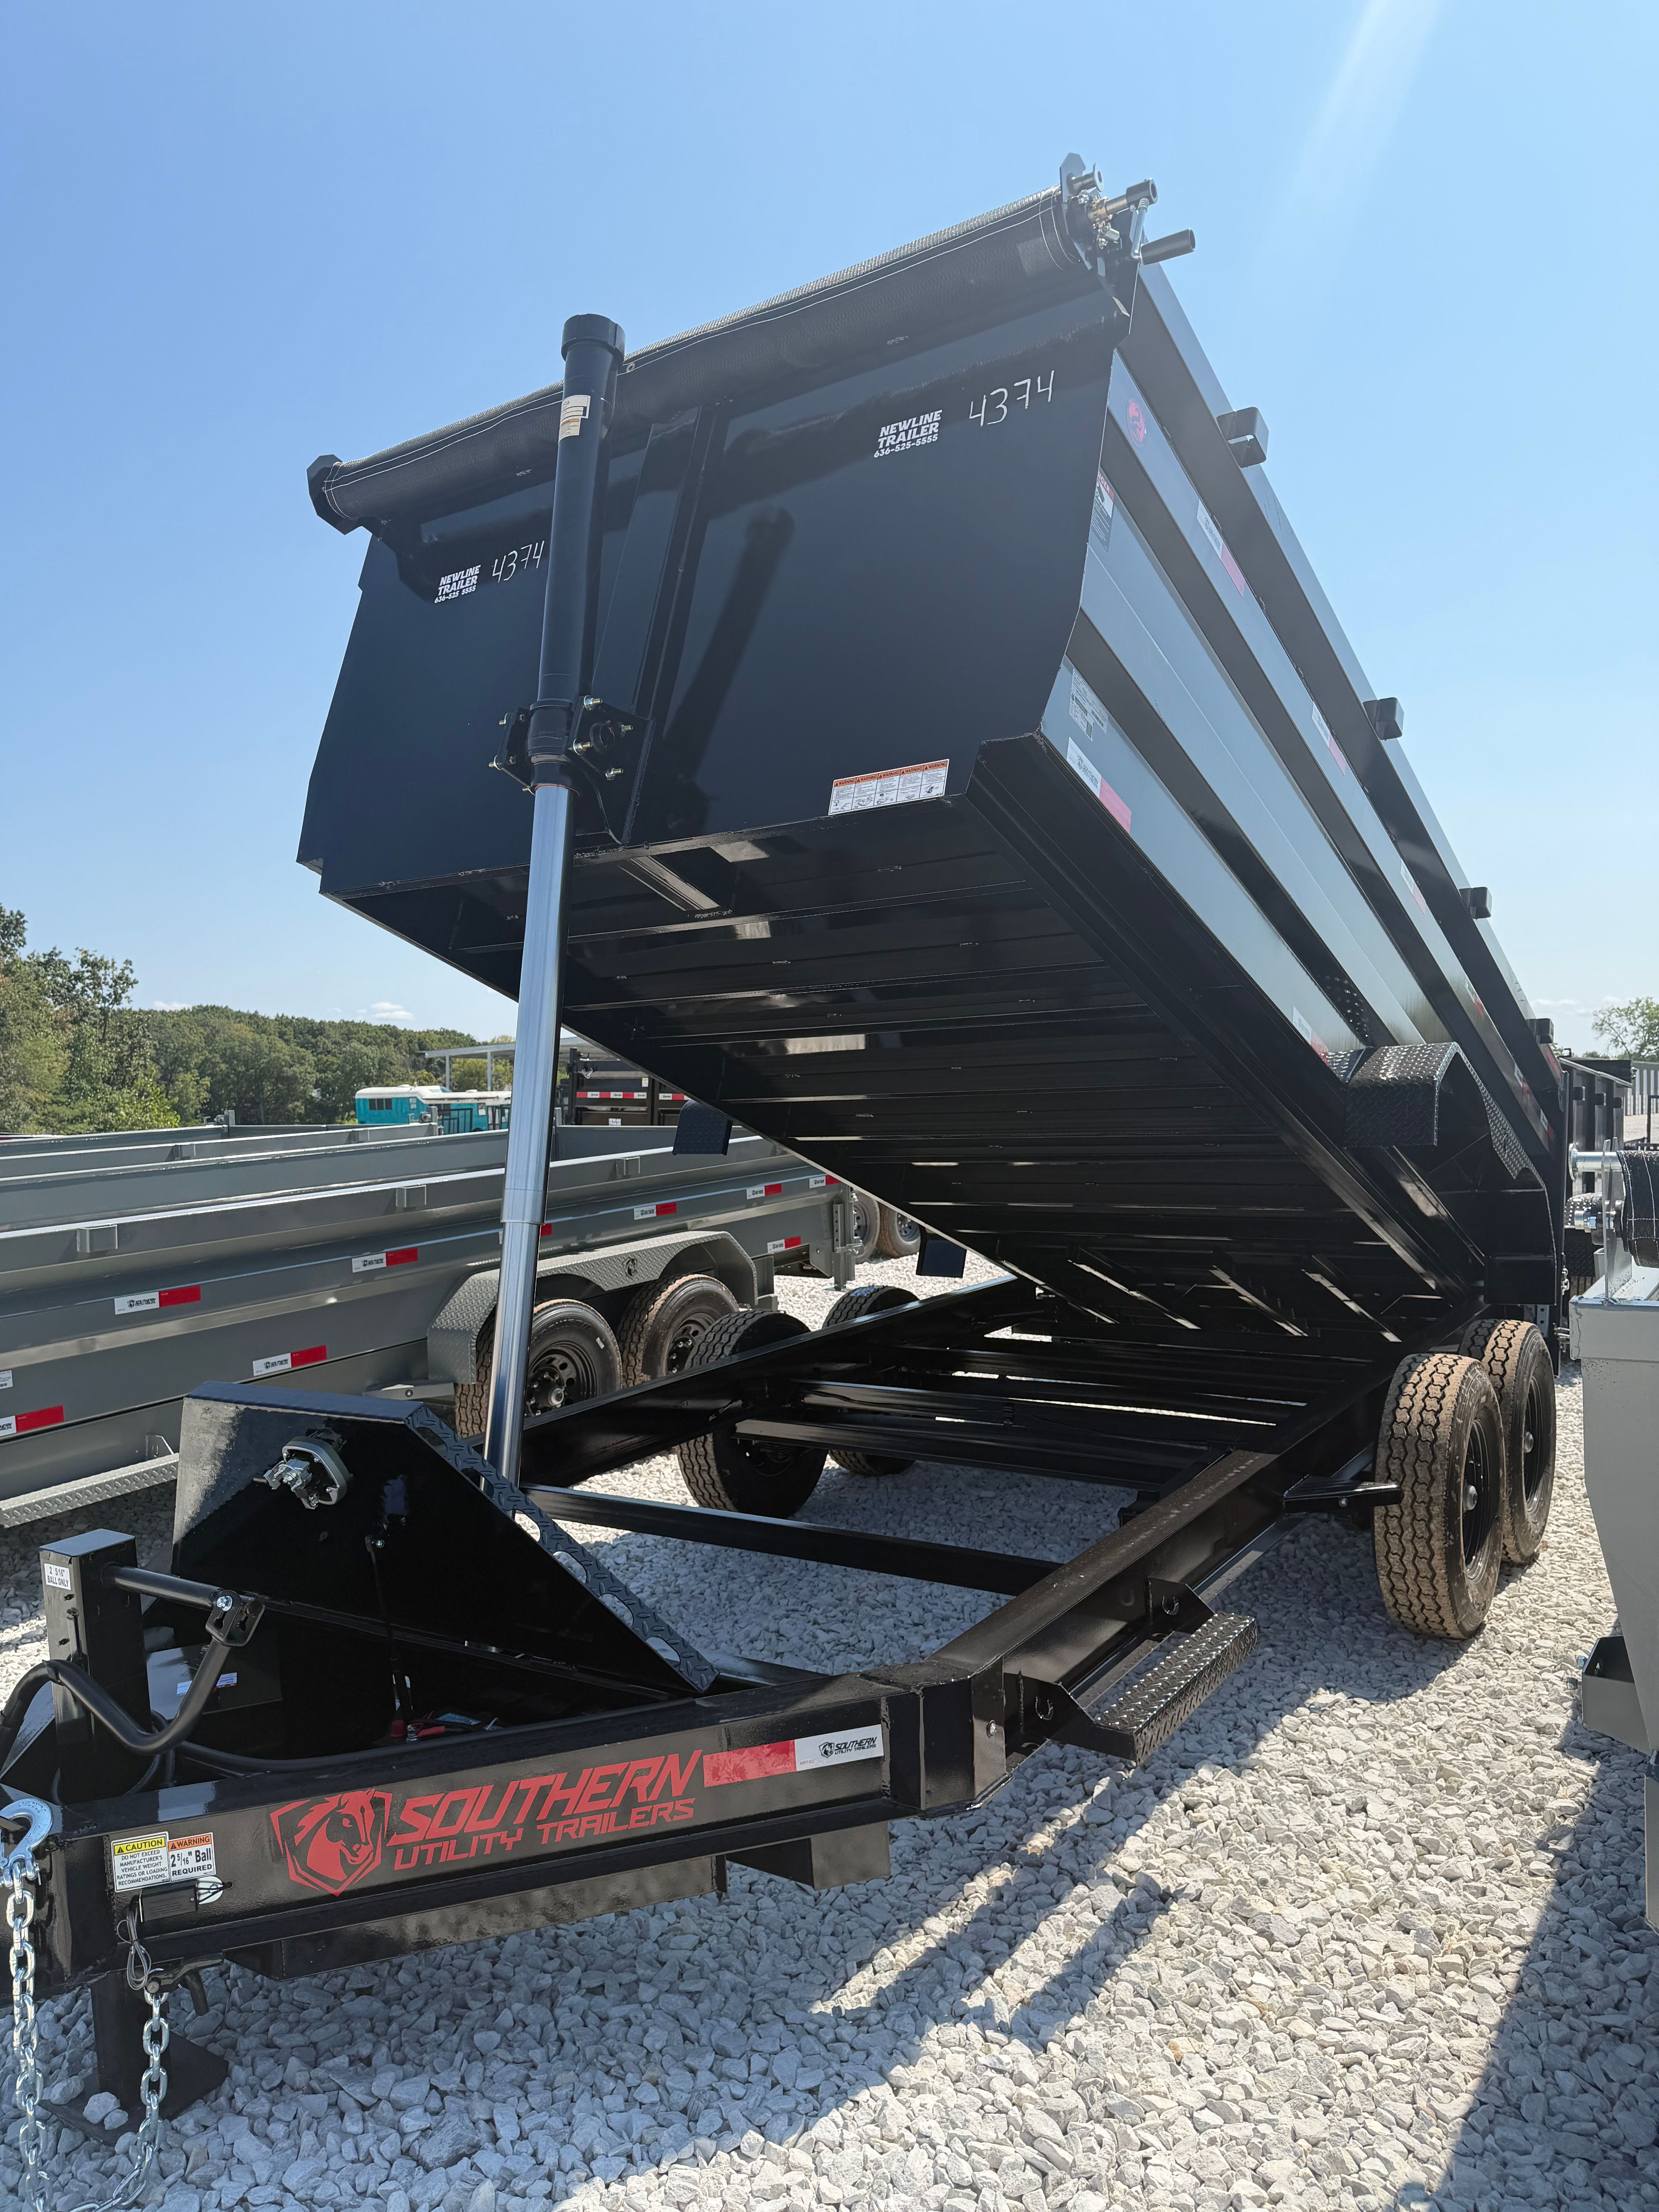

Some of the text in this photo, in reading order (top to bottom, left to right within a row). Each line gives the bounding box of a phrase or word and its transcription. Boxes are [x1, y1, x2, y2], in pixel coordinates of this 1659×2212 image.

[969, 370, 1054, 426] 4374
[880, 409, 942, 438] NEWLINE
[874, 434, 938, 458] 636-525-5555
[878, 422, 939, 449] TRAILER
[492, 541, 544, 583] 4374
[438, 575, 478, 596] TRAILER
[440, 564, 481, 586] NEWLINE
[1082, 764, 1098, 785] SOUTHERN
[47, 1575, 68, 1587] BALL ONLY
[834, 1736, 877, 1751] SOUTHERN
[386, 1749, 702, 1847] SOUTHERN
[126, 1839, 163, 1851] CAUTION
[177, 1836, 210, 1848] WARNING
[394, 1798, 696, 1871] UTILITY TRAILERS
[120, 1855, 163, 1867] MANUFACTURER'S
[170, 1854, 176, 1867] 2
[195, 1848, 211, 1863] Ball
[118, 1874, 167, 1886] RECOMMENDATIONS.
[172, 1864, 212, 1876] REQUIRED
